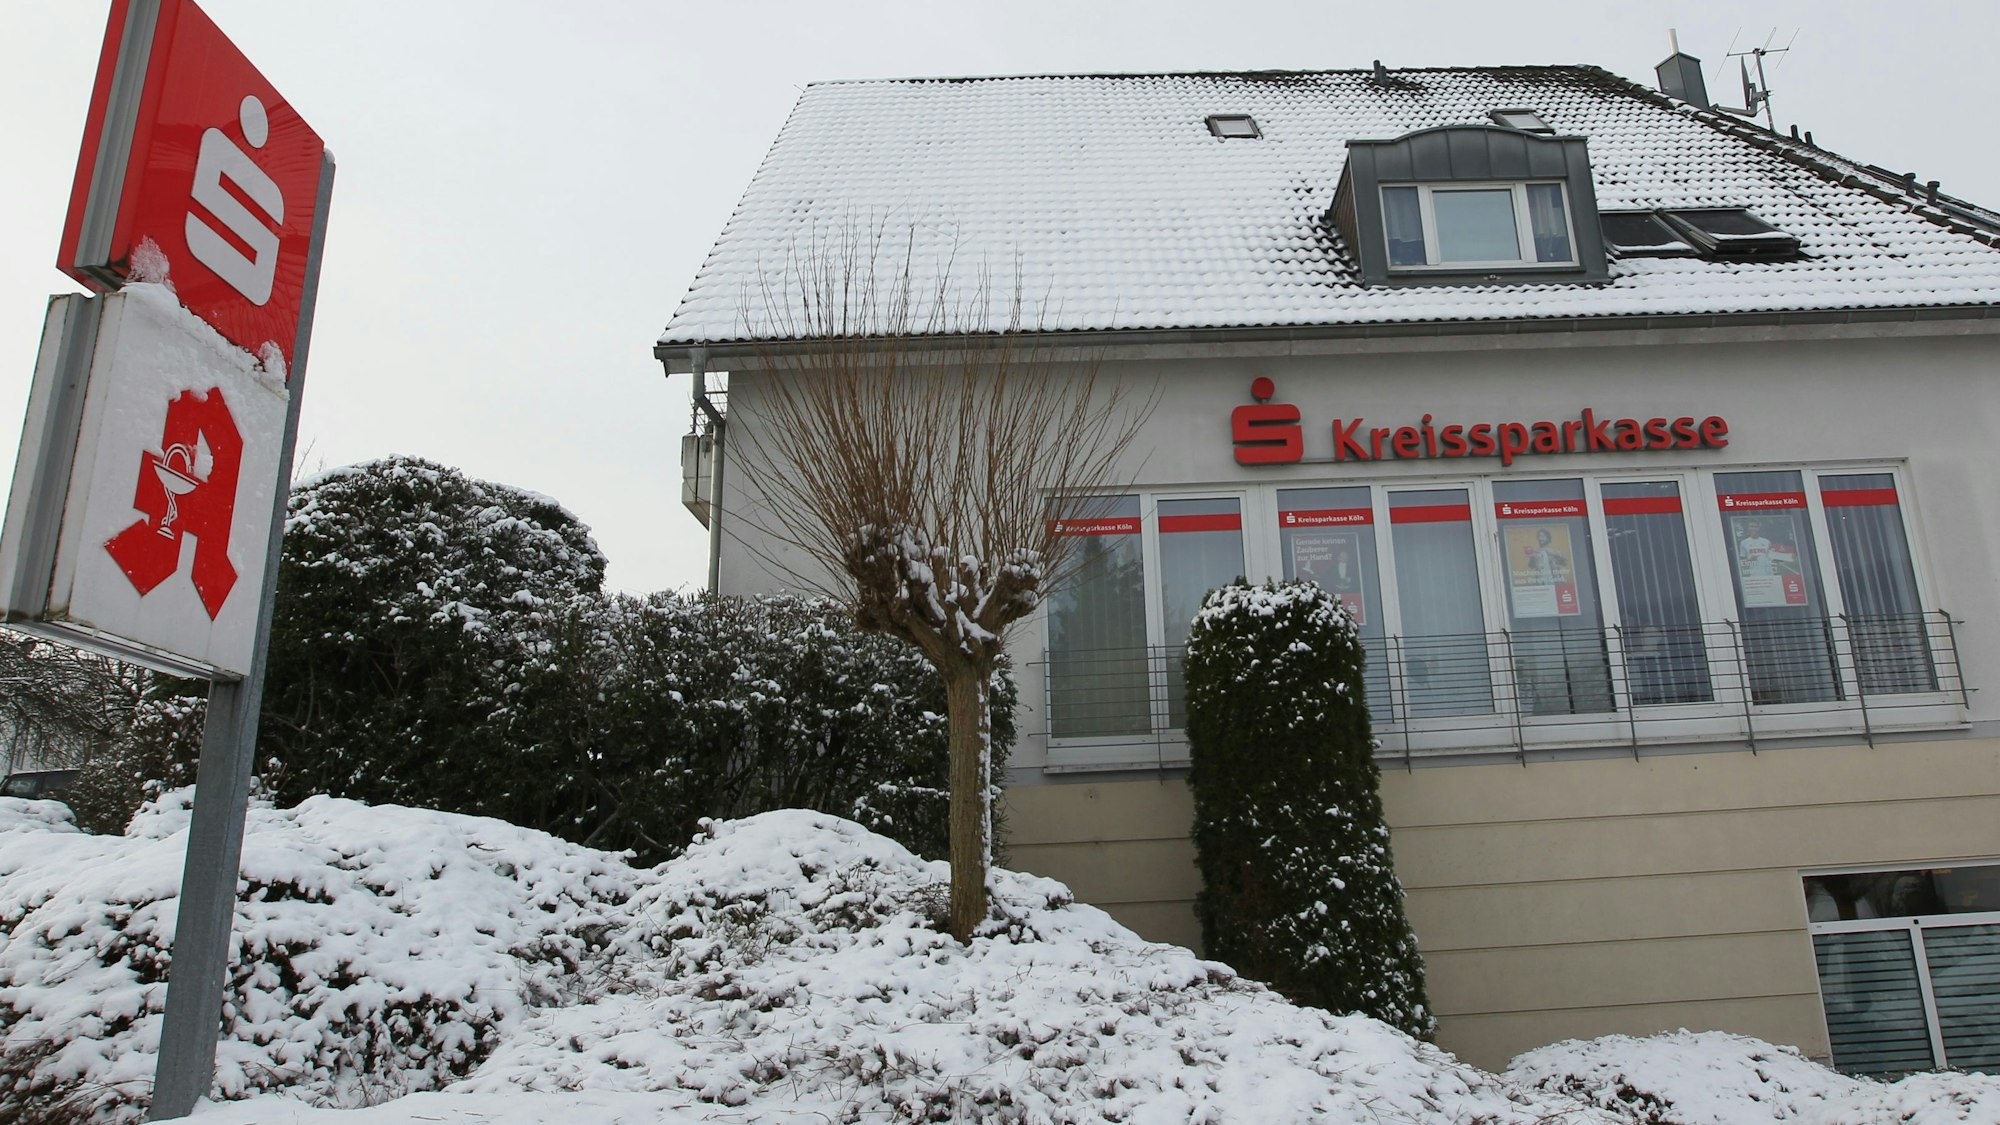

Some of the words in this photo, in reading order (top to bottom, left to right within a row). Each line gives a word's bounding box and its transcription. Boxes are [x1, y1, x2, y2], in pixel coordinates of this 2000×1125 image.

[1332, 408, 1729, 466] Kreissparkasse
[1563, 505, 1578, 513] Köln
[1066, 524, 1116, 532] Krparkasse
[1116, 523, 1133, 531] Köln
[1310, 553, 1332, 561] Hand?
